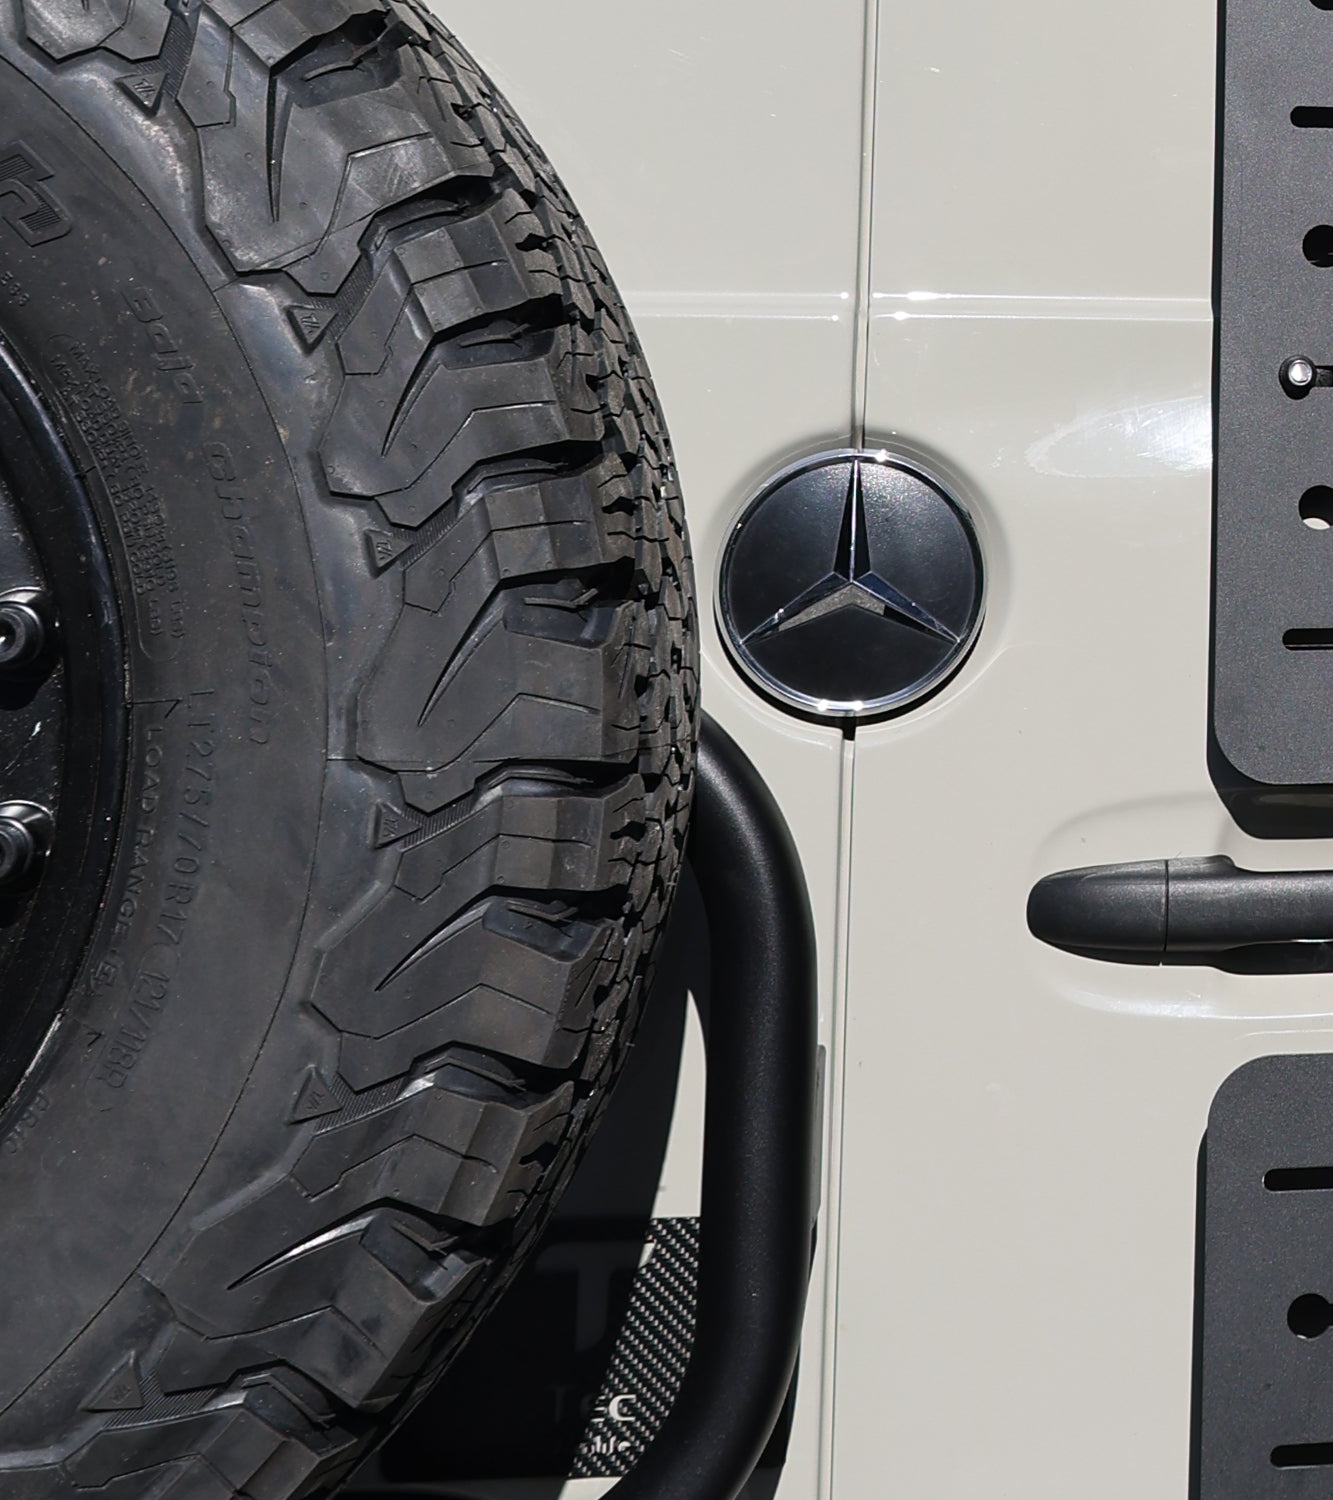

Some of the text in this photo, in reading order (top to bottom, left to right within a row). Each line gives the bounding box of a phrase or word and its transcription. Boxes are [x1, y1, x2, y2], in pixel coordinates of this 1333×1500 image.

[122, 286, 271, 745] Baja Champion
[138, 725, 163, 815] LOAD
[114, 828, 155, 940] RANGE
